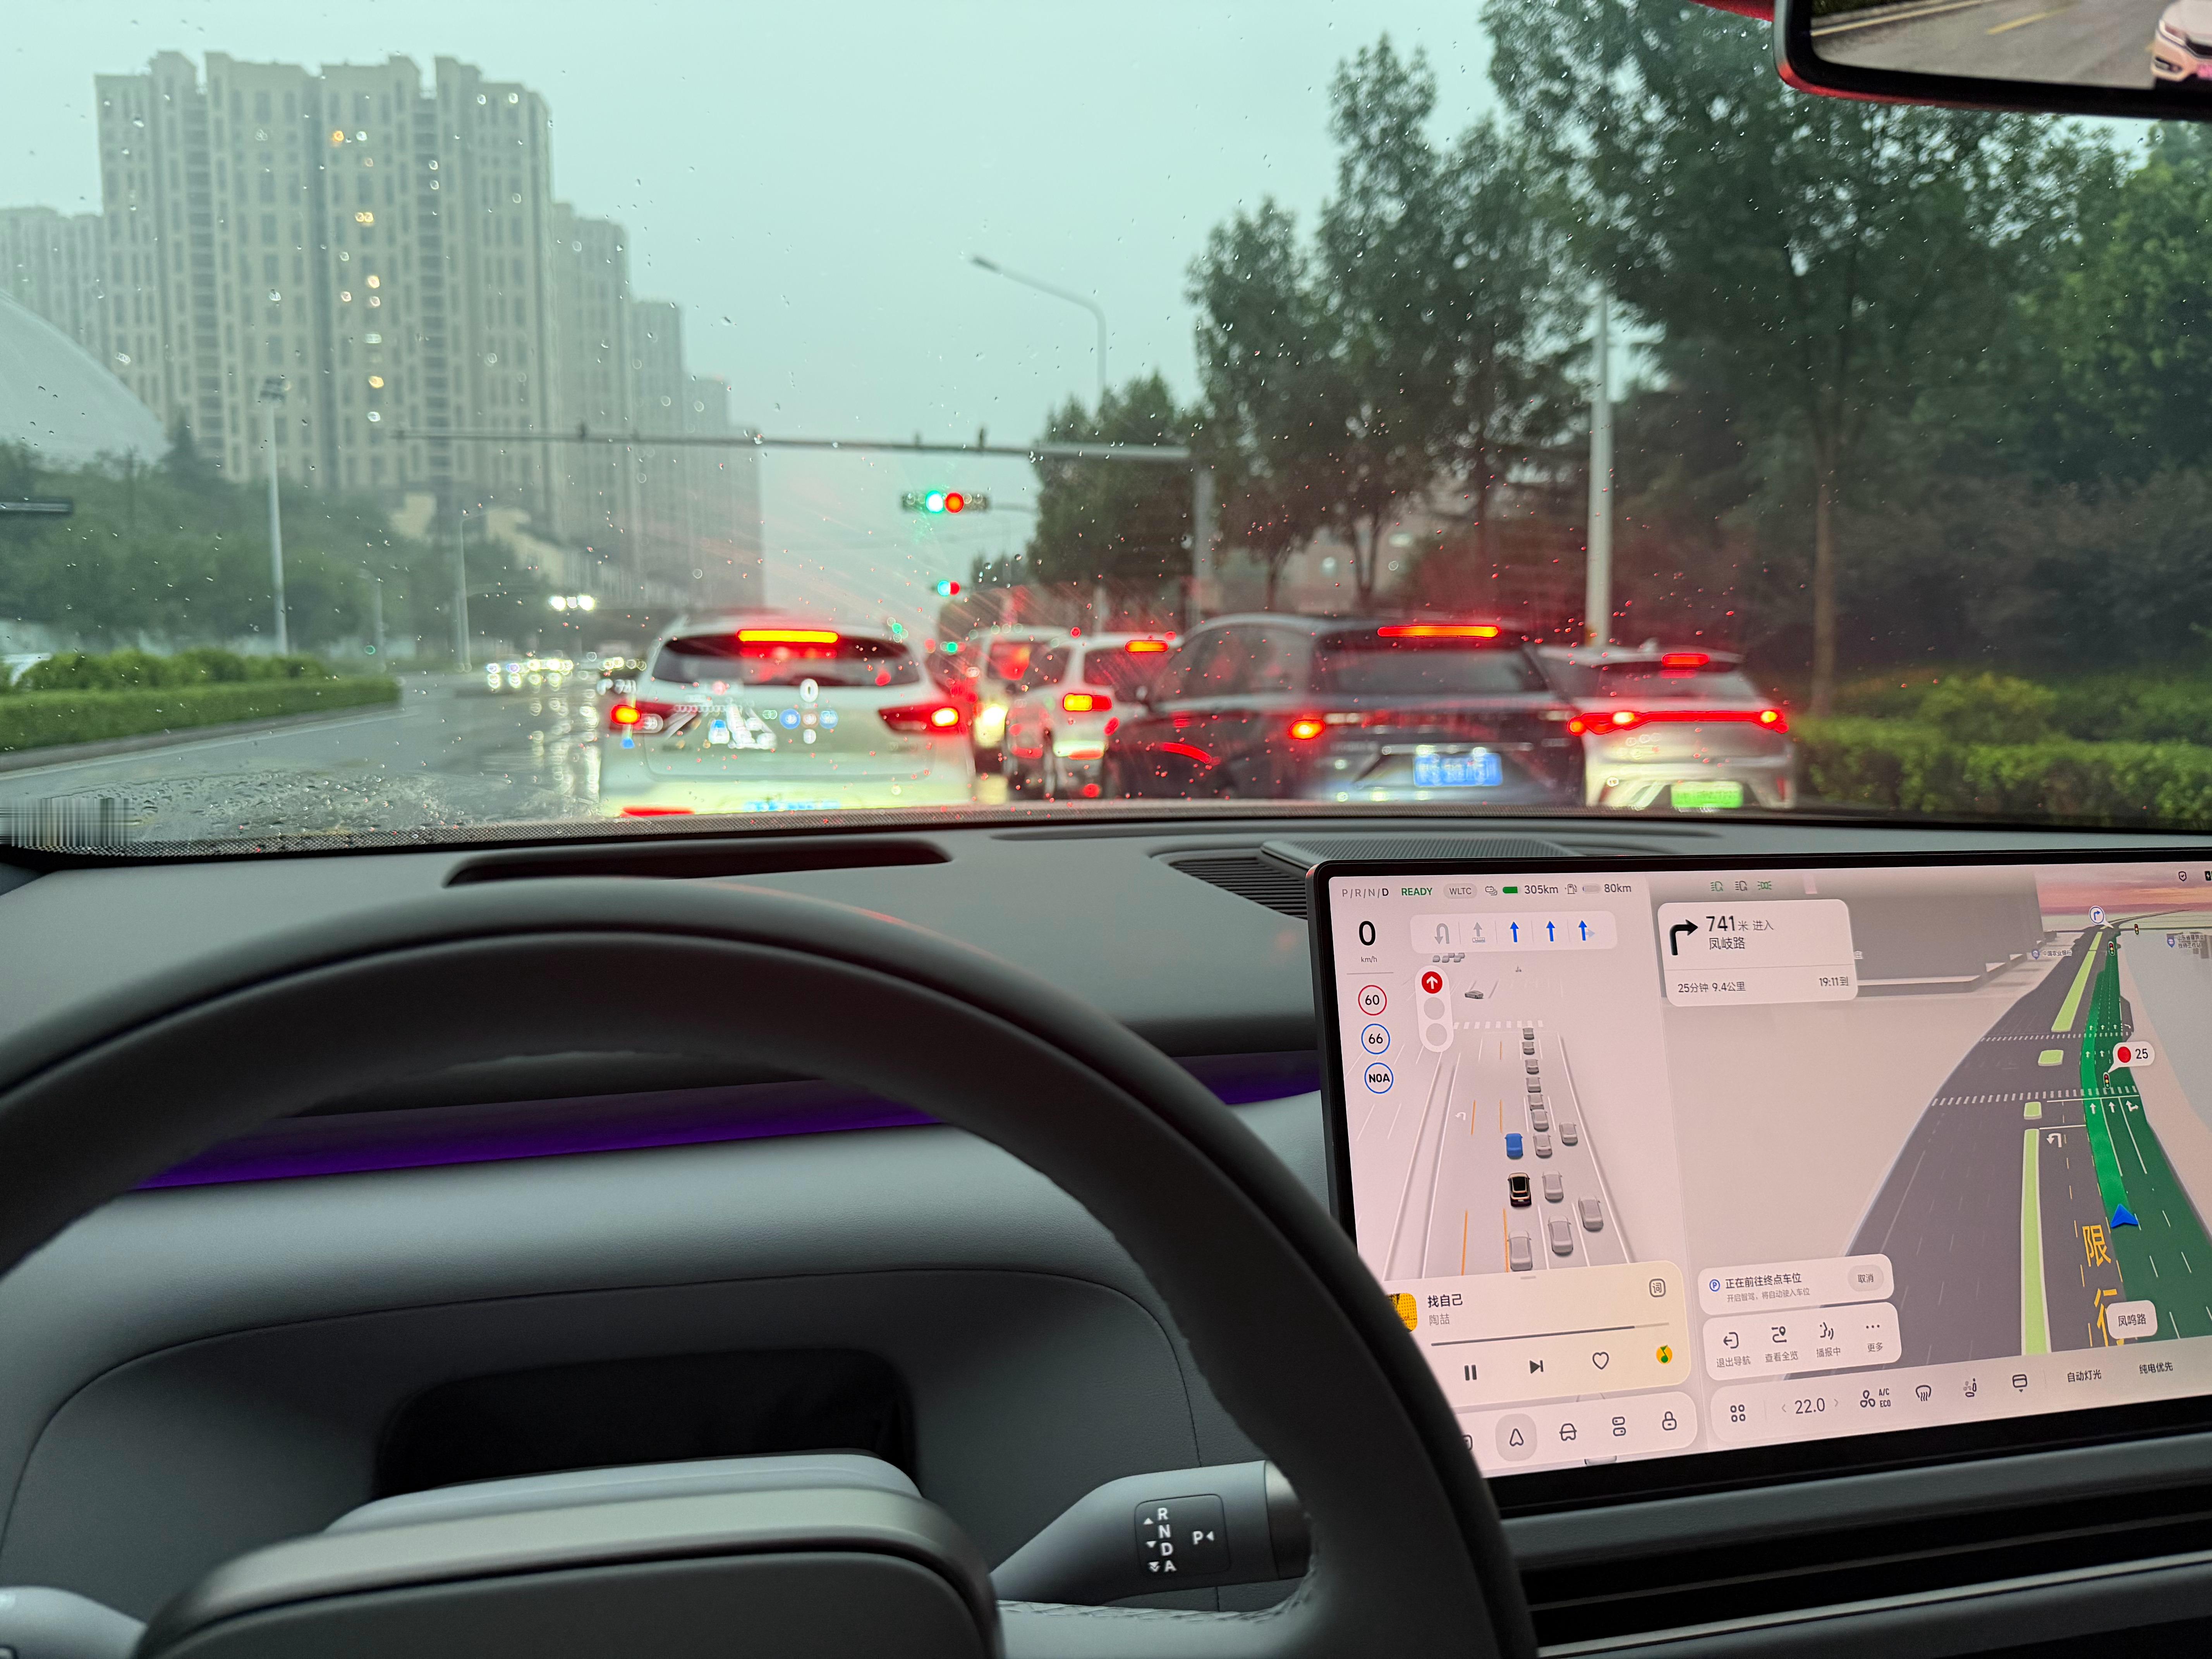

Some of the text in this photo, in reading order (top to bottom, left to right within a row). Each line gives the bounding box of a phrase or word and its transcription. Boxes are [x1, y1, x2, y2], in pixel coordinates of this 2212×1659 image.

[1401, 888, 1433, 896] READY
[1524, 884, 1558, 894] 305km
[1604, 883, 1632, 893] 80km
[1359, 921, 1376, 946] 0
[1709, 936, 1745, 950] 凤岐路
[1678, 976, 1849, 993] 25分钟 9.4公里 19:11到
[1365, 994, 1380, 1005] 60
[1369, 1033, 1383, 1044] 66
[2135, 1048, 2148, 1059] 25
[1368, 1073, 1390, 1084] NOA
[1725, 1273, 1802, 1289] 正在前往终点车位
[1858, 1273, 1874, 1283] 取消
[1652, 1282, 1662, 1294] 词
[1427, 1293, 1463, 1308] 找自己
[1429, 1313, 1450, 1326] 陶喆
[2118, 1313, 2146, 1327] 凤鸣路
[1816, 1346, 1841, 1358] 播报中
[1867, 1342, 1883, 1353] 更多
[1716, 1355, 1751, 1368] 退出导航
[1765, 1350, 1798, 1363] 查看全览
[2139, 1361, 2173, 1374] 纯电优先
[2067, 1369, 2102, 1382] 自动灯光
[1879, 1388, 1889, 1396] A/C
[1795, 1398, 1825, 1414] 22.0
[1879, 1399, 1891, 1408] ECO
[1158, 1507, 1168, 1520] R
[1158, 1524, 1171, 1538] N
[1193, 1531, 1204, 1544] P
[1161, 1542, 1173, 1556] D
[1164, 1560, 1176, 1572] A
